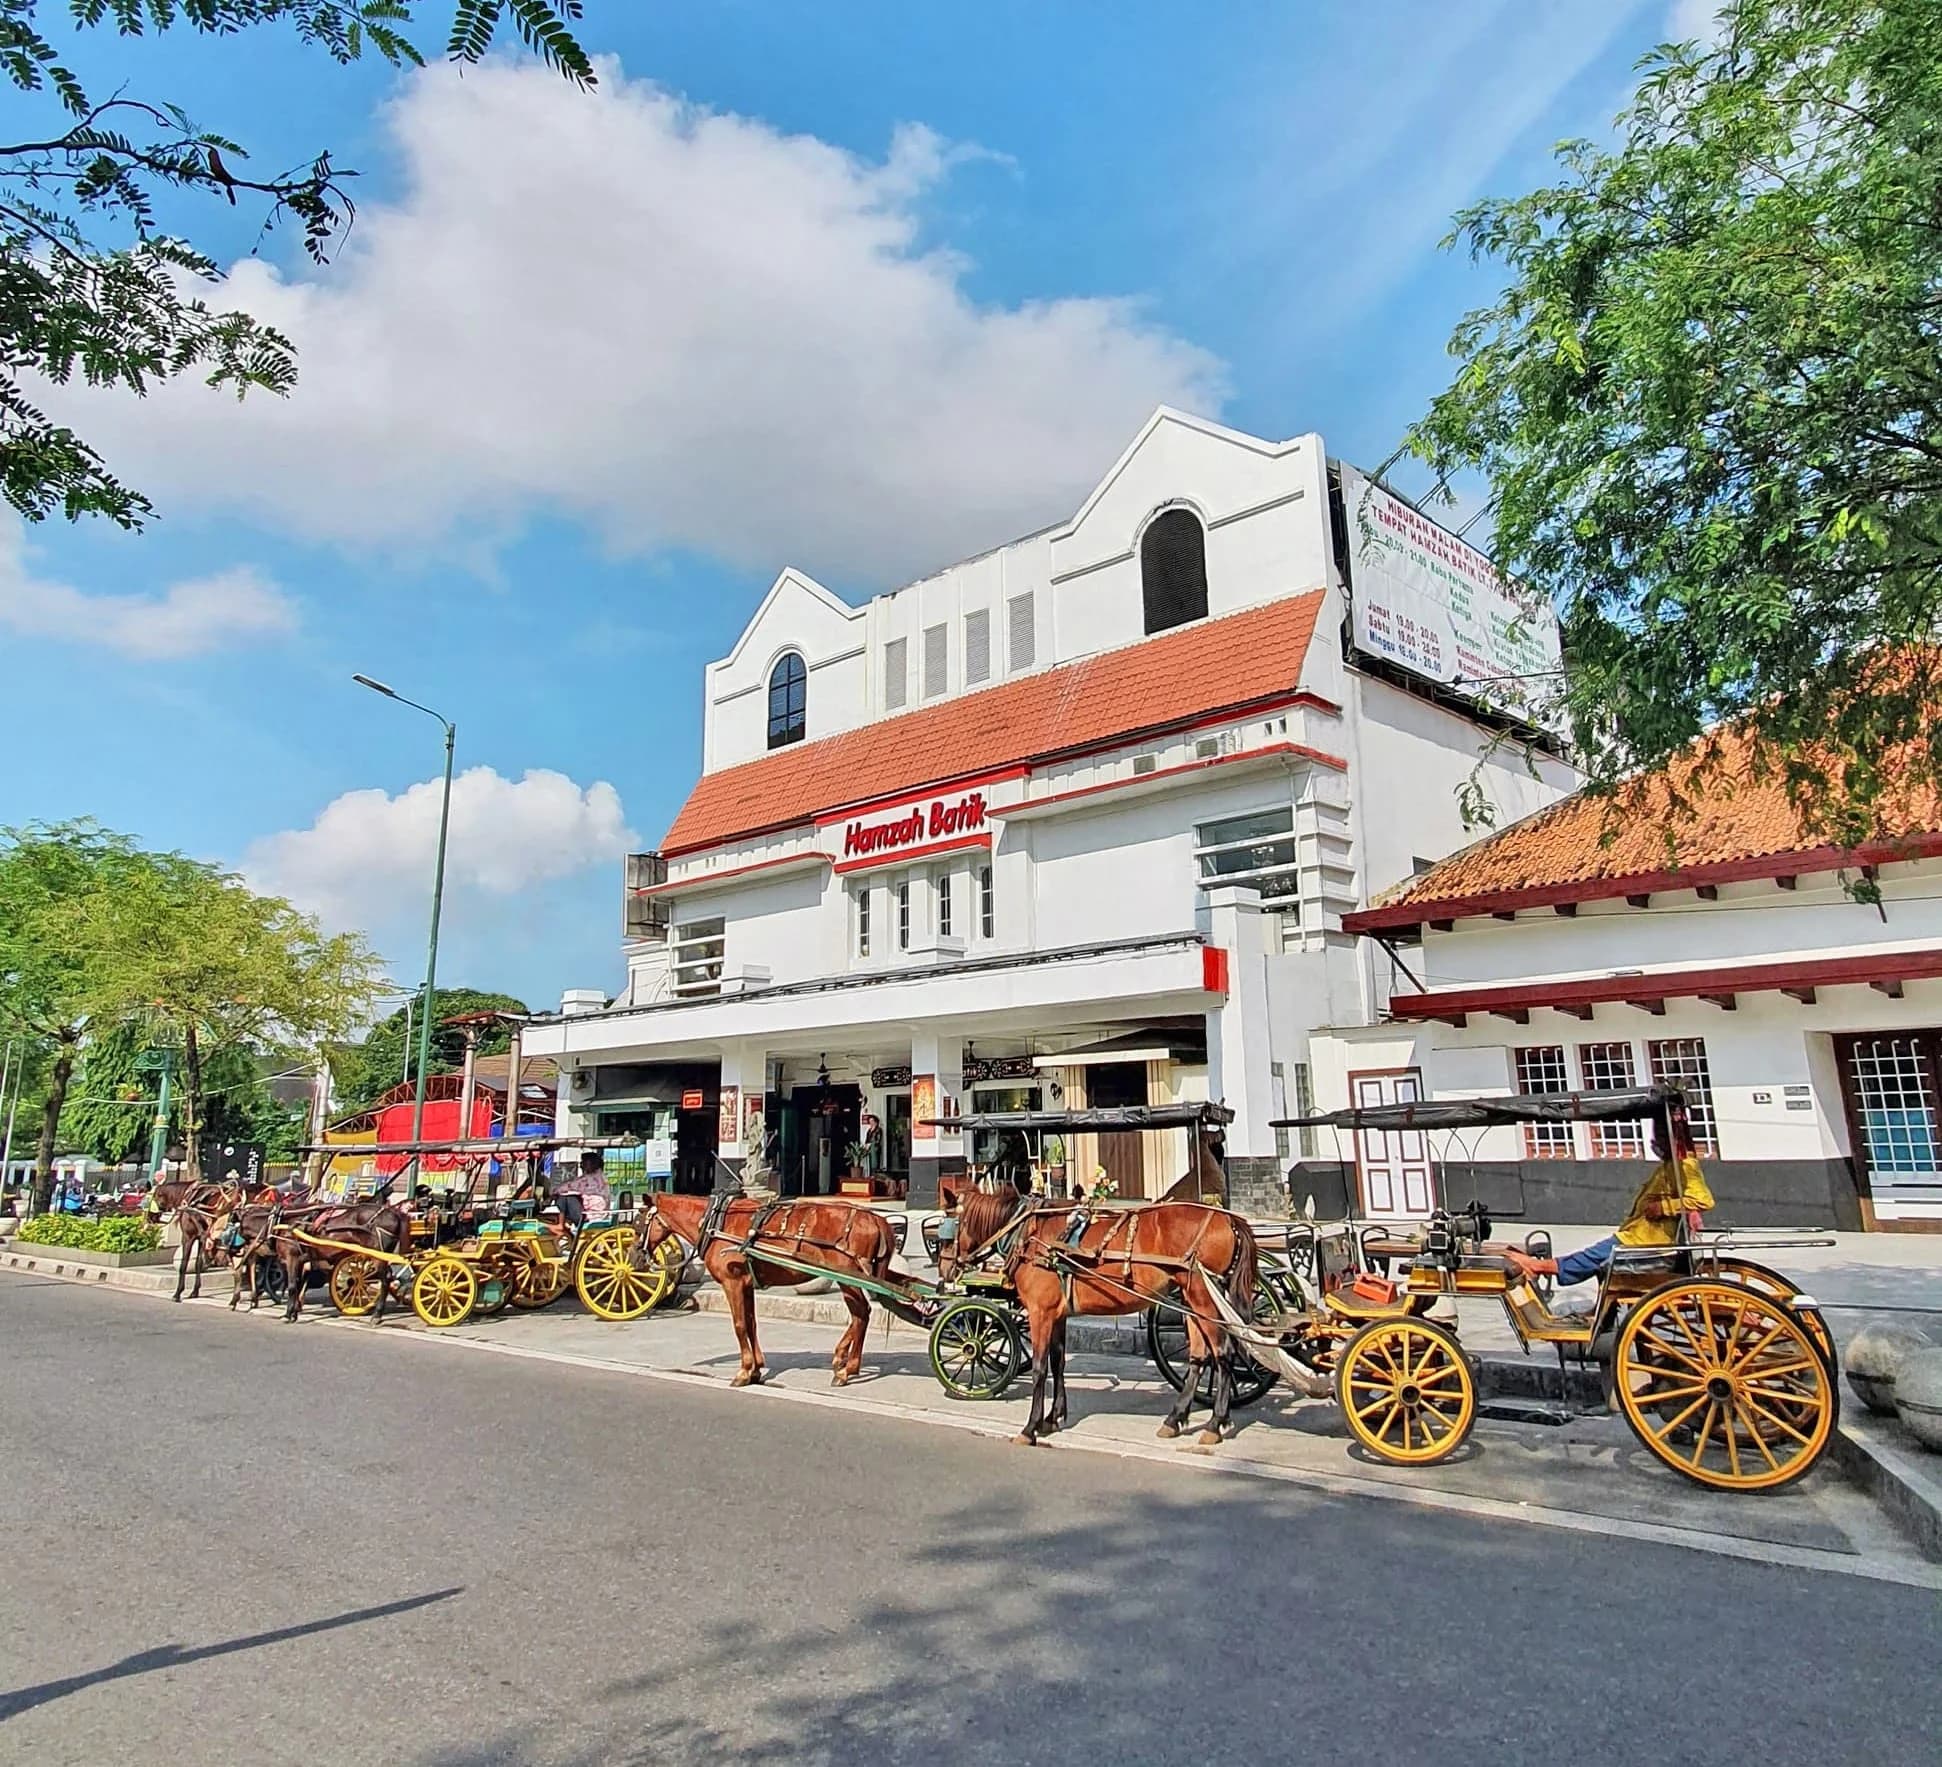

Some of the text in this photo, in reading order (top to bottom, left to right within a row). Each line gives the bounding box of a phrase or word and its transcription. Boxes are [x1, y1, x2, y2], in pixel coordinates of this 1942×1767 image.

[1371, 504, 1407, 537] TEMPAT
[1410, 530, 1450, 564] HAMZAH
[1451, 553, 1477, 580] BATIK
[1387, 499, 1429, 534] HIBURAN
[1430, 527, 1462, 554] MALAM
[1463, 548, 1472, 562] DI
[1368, 599, 1390, 620] Jumat
[1368, 614, 1390, 635] Sabtu
[1369, 629, 1396, 653] Minggu
[844, 793, 987, 857] Hamzah Batik
